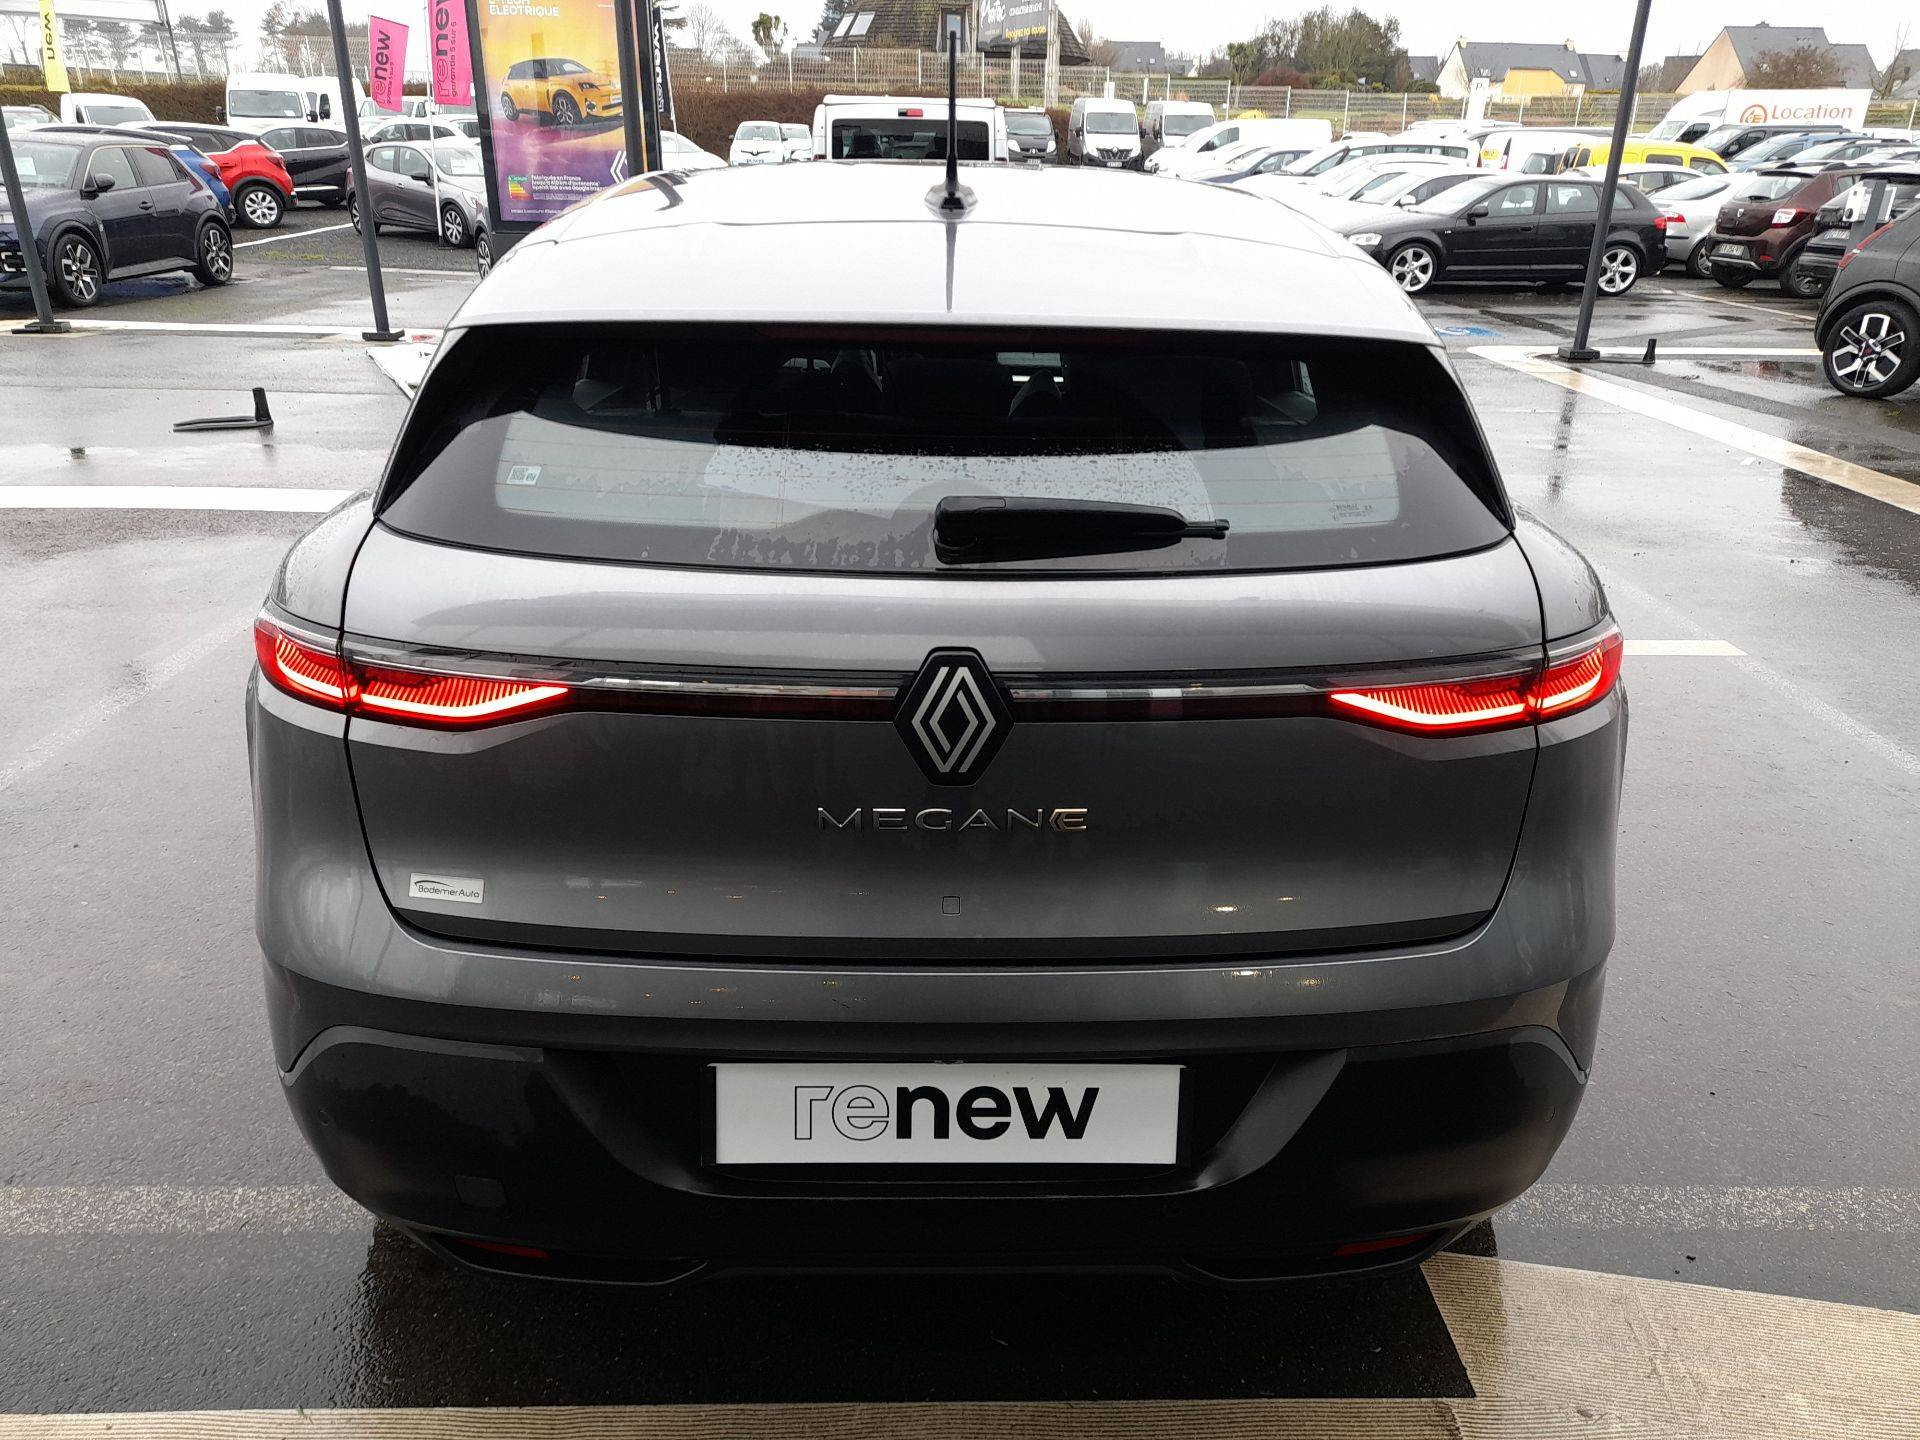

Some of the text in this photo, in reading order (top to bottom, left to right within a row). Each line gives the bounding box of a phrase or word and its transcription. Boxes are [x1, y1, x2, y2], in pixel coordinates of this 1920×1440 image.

[373, 30, 391, 104] renew
[1771, 104, 1853, 120] Location
[818, 808, 1088, 831] MEGANE
[794, 1085, 1100, 1141] renew
